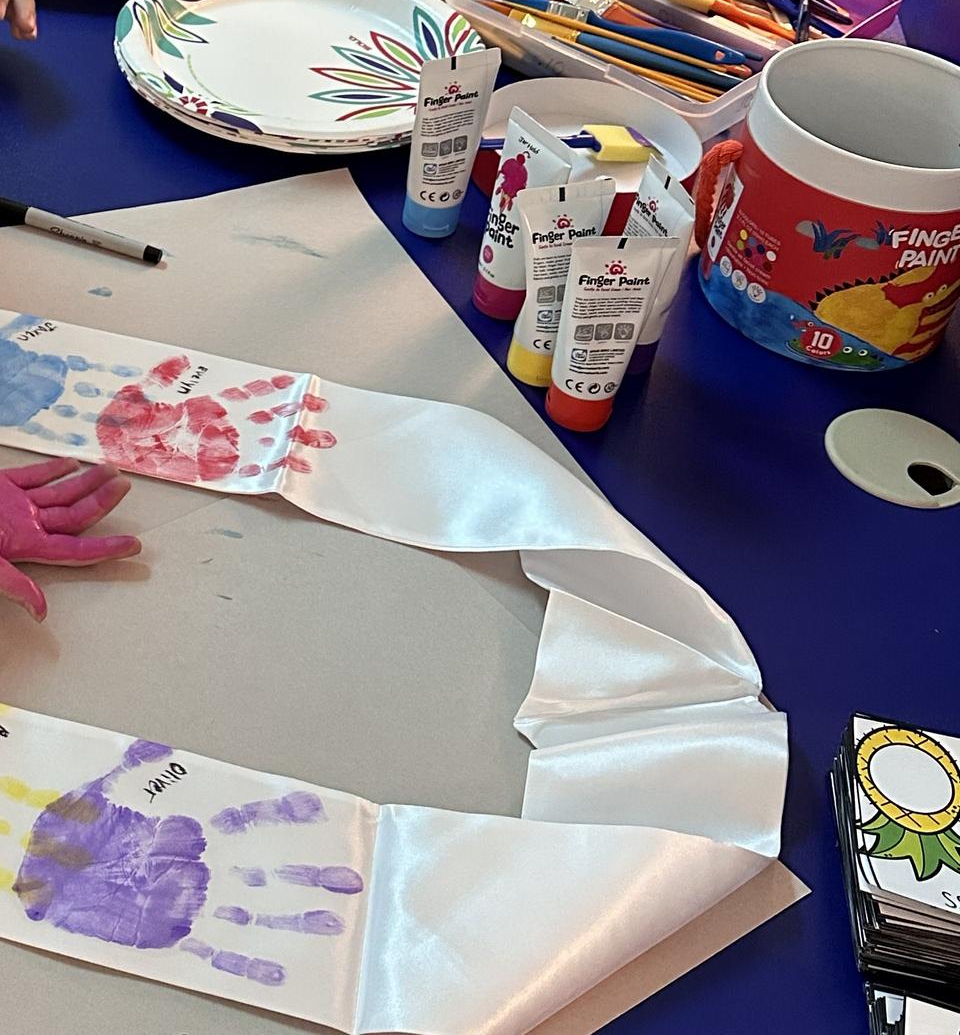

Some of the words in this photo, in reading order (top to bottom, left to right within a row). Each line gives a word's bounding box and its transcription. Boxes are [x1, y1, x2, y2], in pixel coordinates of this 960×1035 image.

[423, 95, 453, 108] Finger
[455, 90, 479, 103] Paint
[489, 208, 520, 235] inger
[532, 231, 565, 245] Finger
[568, 226, 597, 240] Paint
[892, 223, 960, 249] FINGE
[898, 246, 960, 268] PAINT
[578, 274, 616, 287] Finger
[618, 276, 650, 287] Paint
[805, 344, 831, 356] Colors
[811, 330, 834, 350] 10
[143, 762, 188, 804] Oliver
